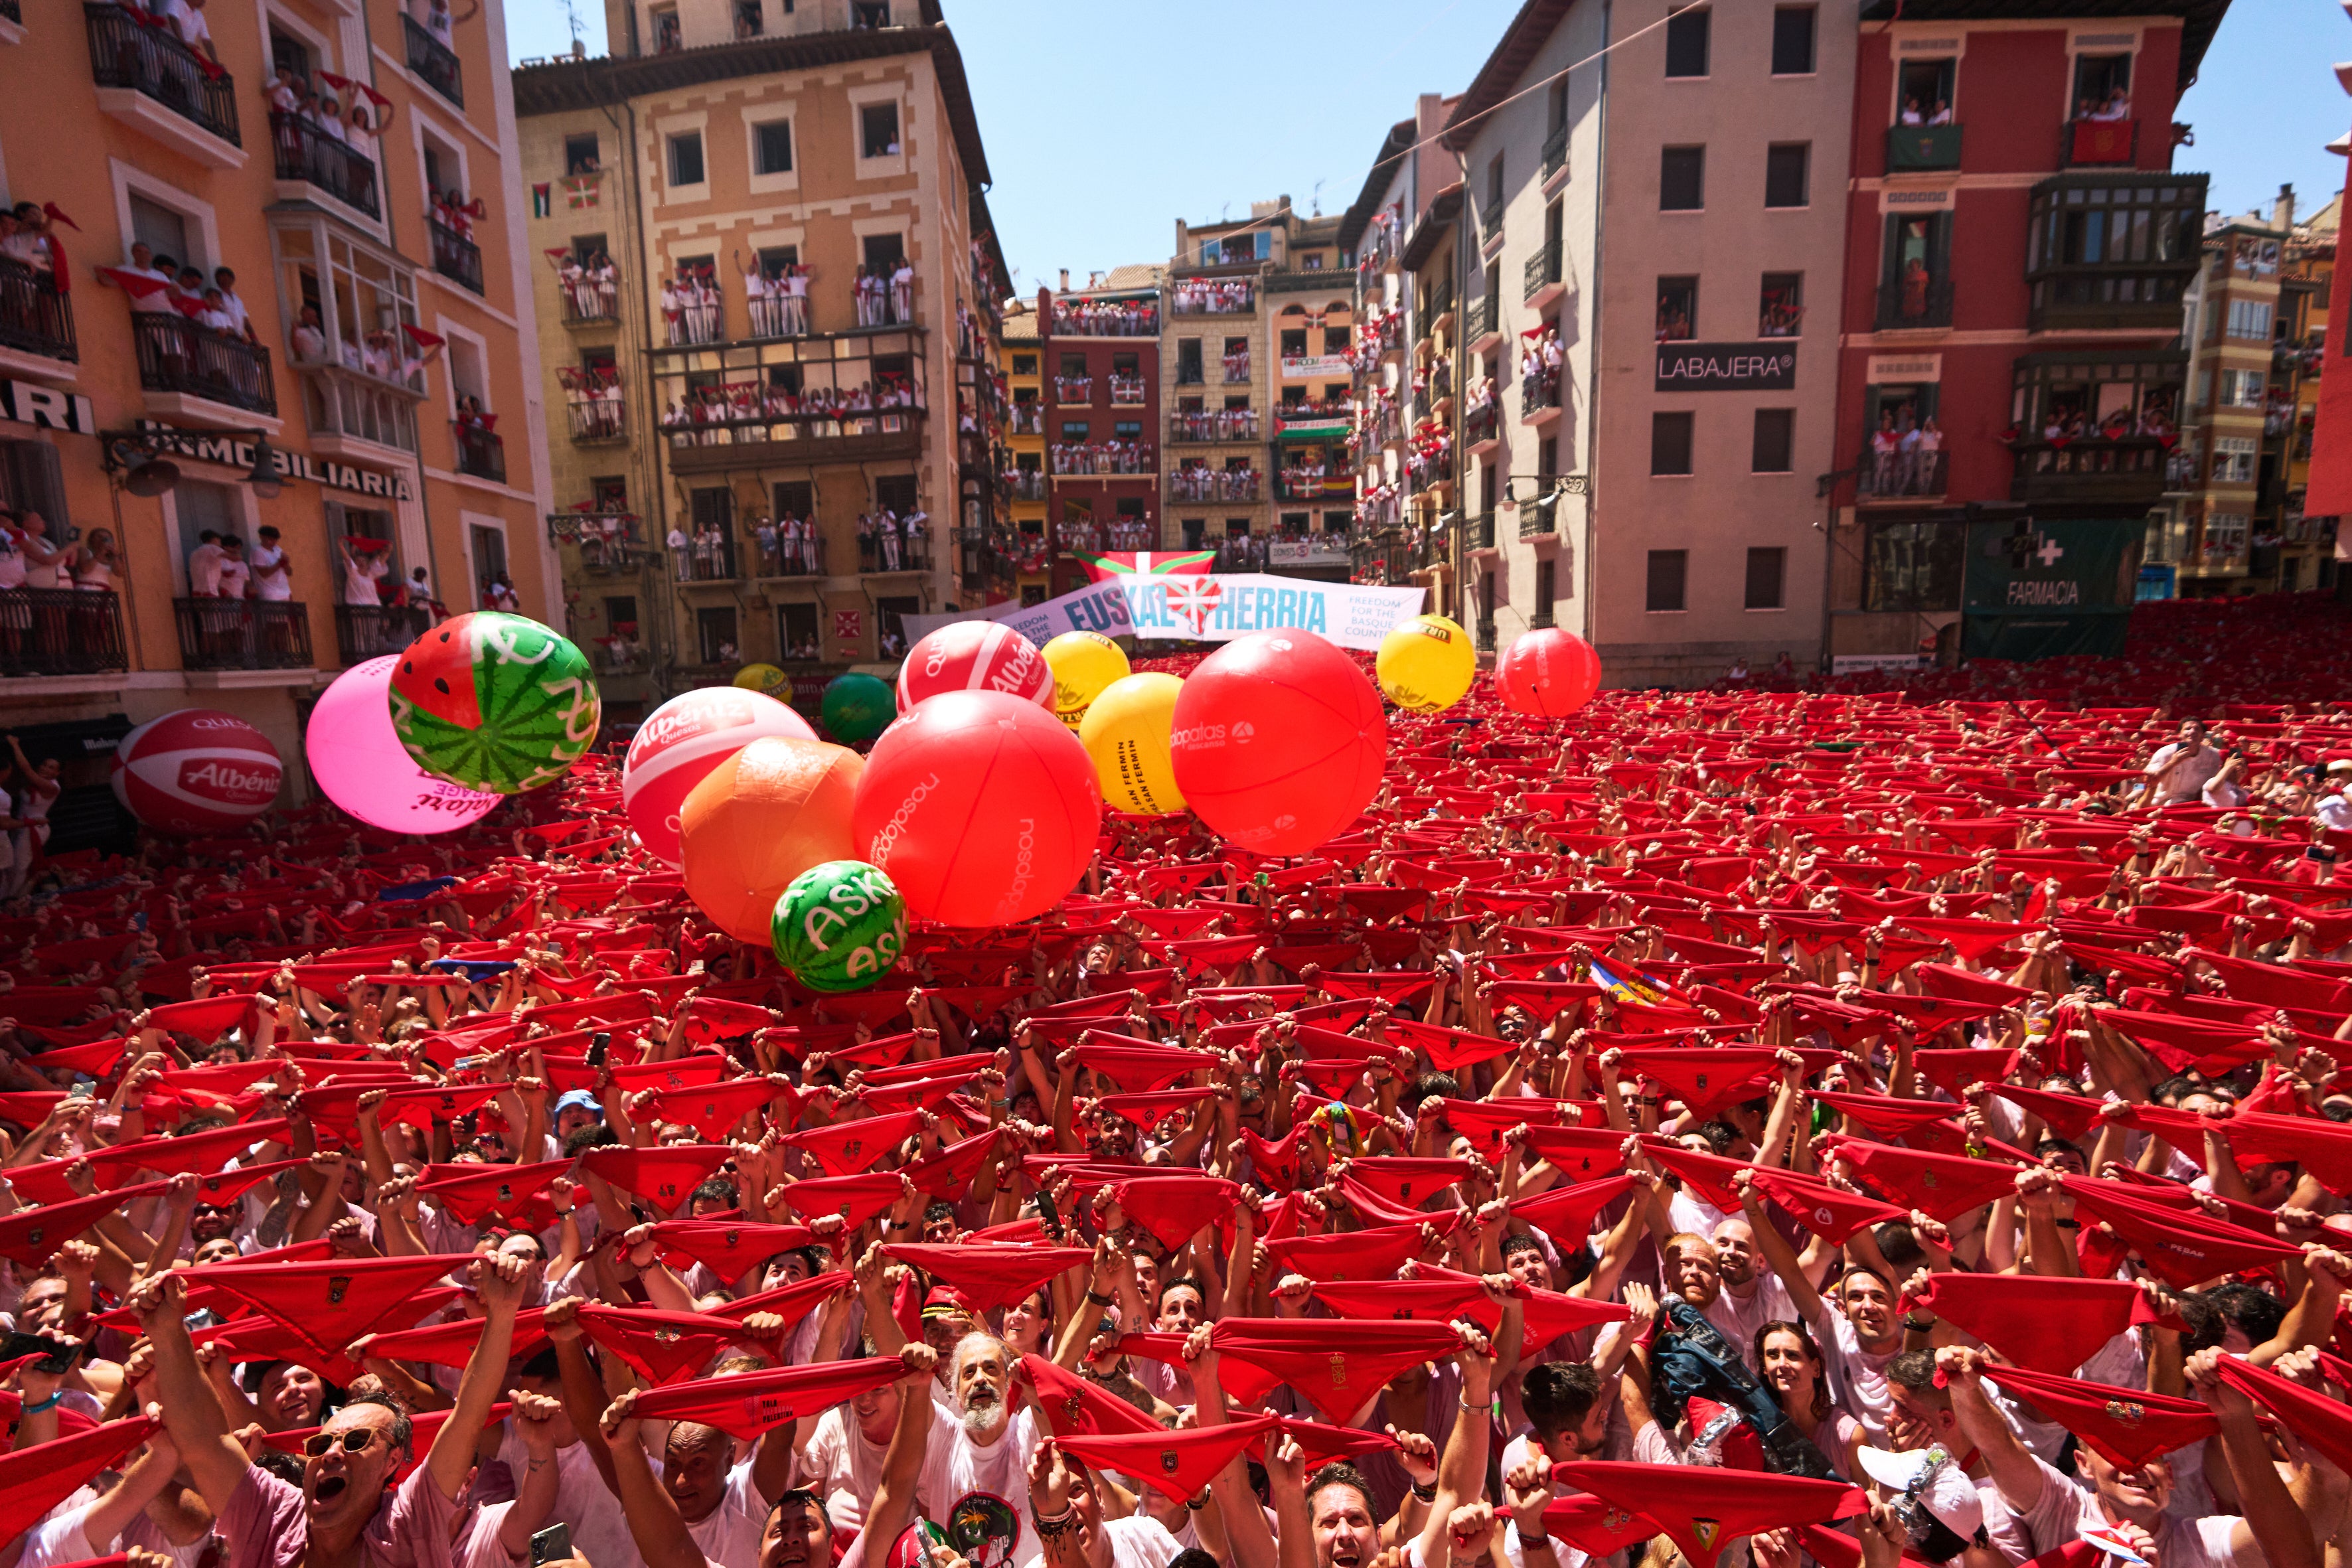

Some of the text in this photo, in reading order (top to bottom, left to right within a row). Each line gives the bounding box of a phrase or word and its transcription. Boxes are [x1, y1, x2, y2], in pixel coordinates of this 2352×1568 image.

[0, 379, 96, 435] RI
[2007, 580, 2078, 605] FARMACIA
[1063, 585, 1327, 633] EUSKAL HERRIA
[1348, 596, 1401, 609] FREEDOM
[1352, 605, 1396, 619] FOR THE
[1351, 616, 1393, 629] BASQUE
[660, 722, 702, 745] Quesos
[1128, 789, 1142, 805] SAN
[1140, 785, 1154, 803] SAN
[2170, 1243, 2205, 1257] PEBAR
[763, 1410, 793, 1423] PALESTINA
